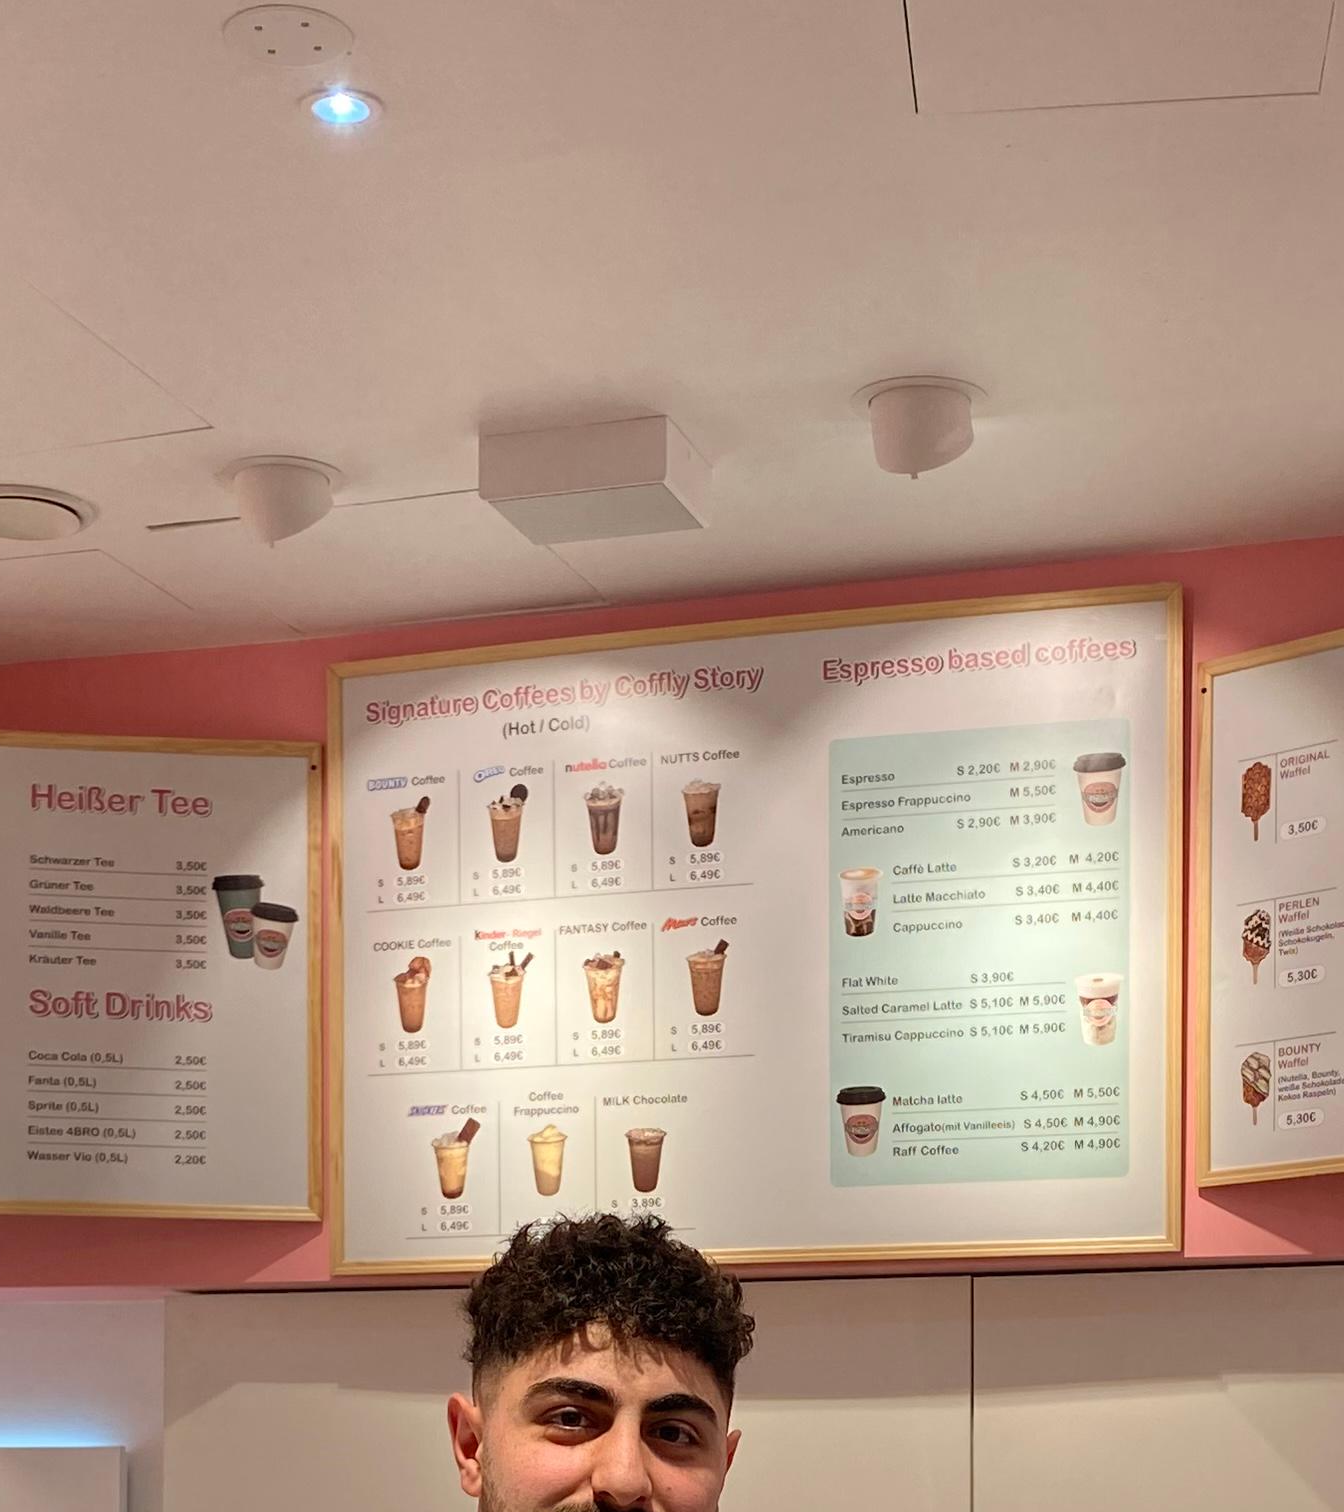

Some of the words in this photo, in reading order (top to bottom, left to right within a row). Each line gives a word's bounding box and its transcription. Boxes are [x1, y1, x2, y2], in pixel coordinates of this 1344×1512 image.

[823, 655, 944, 686] Espresso
[948, 643, 1029, 672] based
[1035, 637, 1136, 665] coffees
[366, 695, 478, 726] Signature
[483, 686, 573, 713] Coffees
[579, 677, 610, 704] by
[615, 672, 690, 701] Coffly
[694, 666, 764, 693] Story
[502, 720, 535, 738] (Hot
[548, 715, 590, 733] Cold)
[661, 752, 700, 764] NUTTS
[703, 750, 740, 761] Coffee
[1280, 751, 1329, 768] ORIGINAL
[509, 765, 543, 777] Coffee
[565, 760, 607, 772] nutella
[609, 757, 647, 769] Coffee
[841, 772, 894, 786] Espresso
[957, 765, 964, 776] S
[968, 763, 1000, 775] 2,20€
[1009, 762, 1019, 772] M
[1022, 760, 1055, 772] 2,90€
[1280, 766, 1310, 779] Waffel
[30, 784, 143, 814] Heißer
[152, 789, 212, 817] Tee
[841, 824, 904, 837] Americano
[1288, 819, 1318, 834] 3,50€
[30, 855, 91, 867] Schwarzer
[94, 857, 115, 867] Tee
[690, 853, 720, 863] 5,89€
[175, 861, 207, 872] 3,50€
[893, 864, 924, 875] Caffè
[927, 863, 956, 874] Latte
[893, 893, 922, 903] Latte
[925, 889, 985, 902] Macchiato
[1279, 897, 1320, 913] PERLEN
[893, 919, 963, 933] Cappuccino
[1015, 916, 1023, 925] S
[1026, 913, 1059, 926] 3,40€
[1072, 912, 1081, 922] M
[1084, 909, 1118, 922] 4,40€
[559, 922, 608, 935] FANTASY
[612, 921, 647, 932] Coffee
[373, 940, 415, 951] COOKIE
[418, 938, 451, 948] Coffee
[842, 978, 863, 988] Flat
[866, 976, 898, 986] White
[970, 973, 977, 983] S
[980, 972, 1014, 984] 3,90€
[29, 989, 98, 1018] Soft
[106, 992, 213, 1022] Drinks
[842, 1004, 878, 1016] Salted
[882, 1002, 929, 1014] Caramel
[933, 1000, 962, 1011] Latte
[842, 1031, 892, 1043] Tiramisu
[894, 1028, 964, 1042] Cappuccino
[1278, 1043, 1321, 1057] BOUNTY
[28, 1051, 57, 1062] Coca
[61, 1051, 87, 1062] Cola
[90, 1051, 123, 1064] (0,5L)
[175, 1055, 206, 1066] 2,50€
[28, 1075, 60, 1086] Fanta
[64, 1076, 97, 1088] (0,5L)
[175, 1080, 206, 1091] 2,50€
[529, 1092, 563, 1101] Coffee
[603, 1095, 630, 1106] MILK
[633, 1093, 687, 1105] Chocolate
[893, 1095, 935, 1106] Matcha
[938, 1094, 962, 1104] latte
[28, 1100, 62, 1113] Sprite
[66, 1101, 99, 1113] (0,5L)
[514, 1105, 579, 1117] Frappuccino
[27, 1151, 71, 1162] Wasser
[75, 1152, 91, 1162] Vio
[95, 1152, 128, 1164] (0,5L)
[175, 1155, 206, 1166] 2,20€
